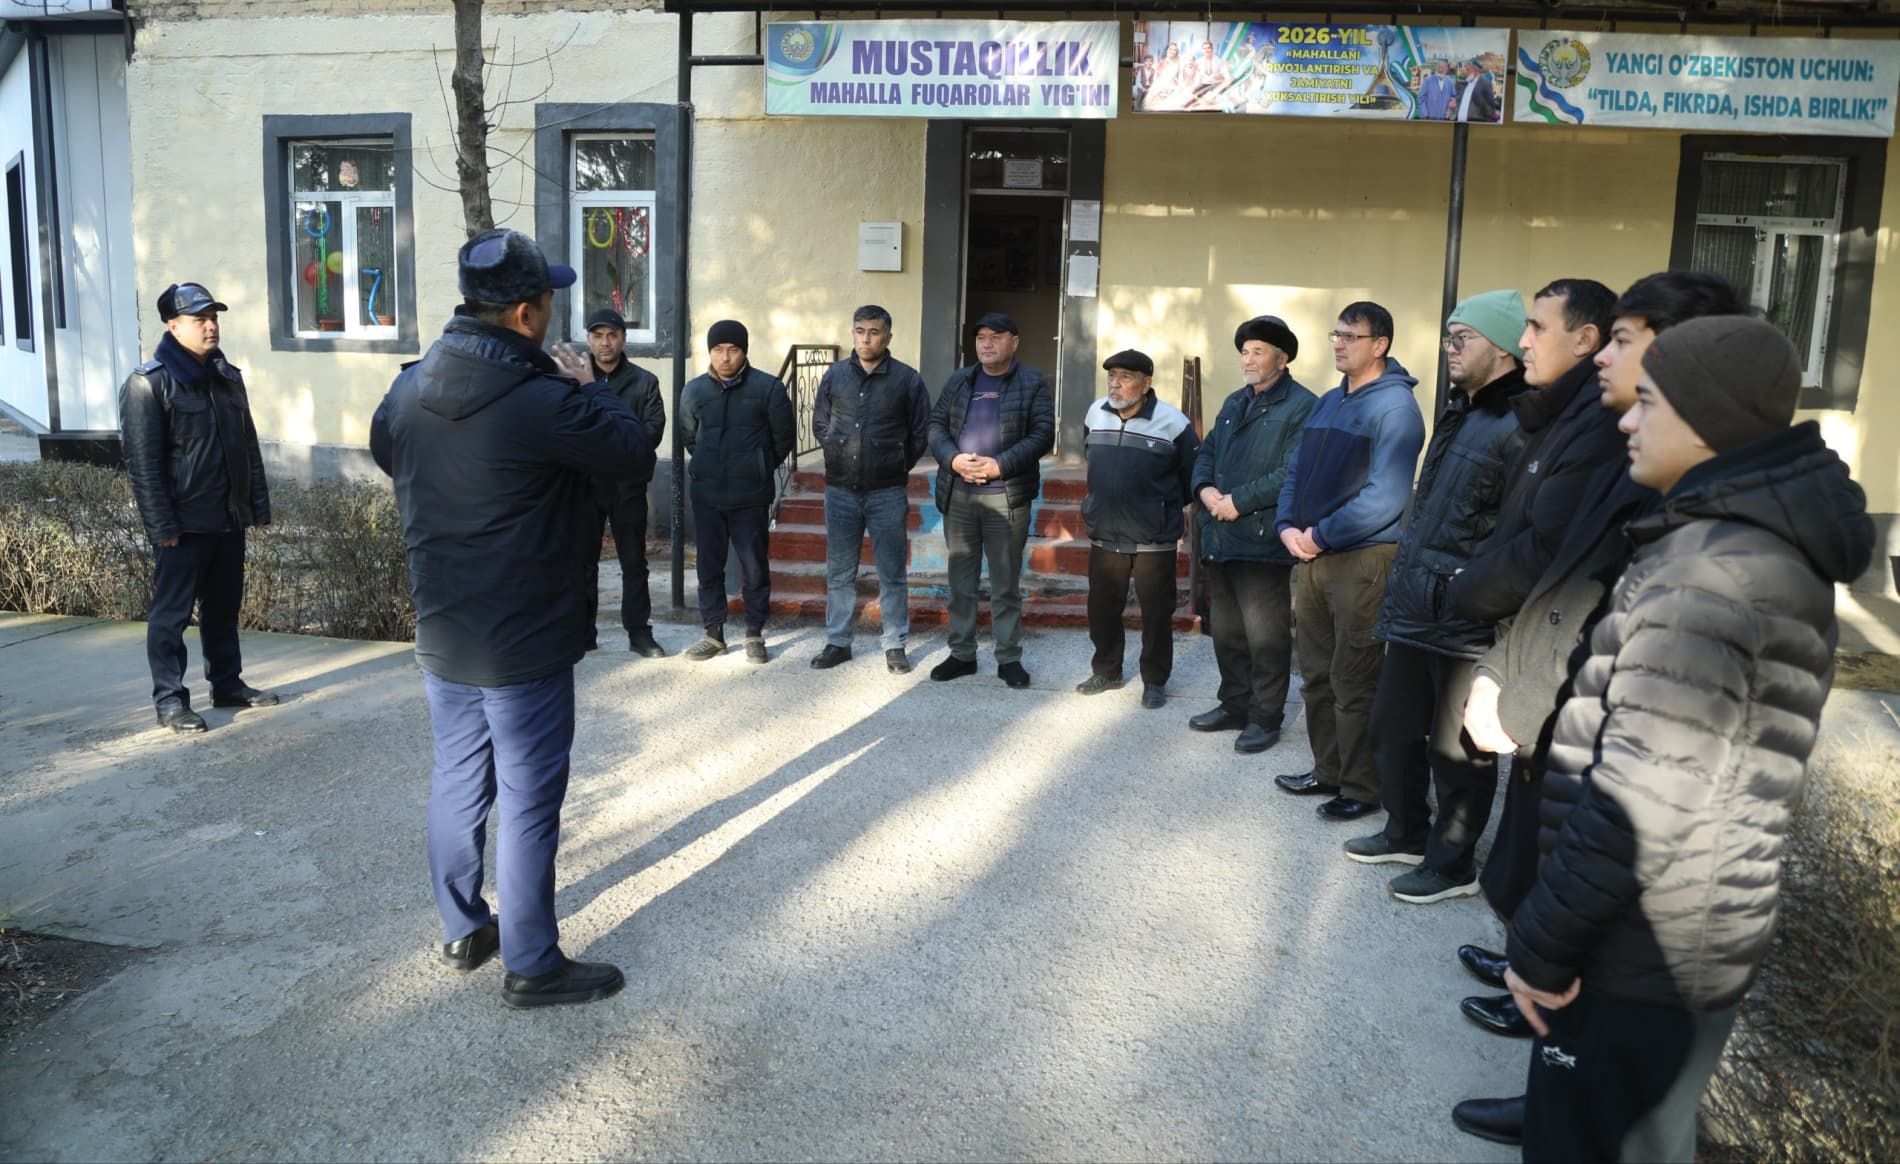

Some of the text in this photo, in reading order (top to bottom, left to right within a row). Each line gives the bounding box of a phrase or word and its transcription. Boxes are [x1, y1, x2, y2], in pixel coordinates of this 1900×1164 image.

[1277, 26, 1373, 45] 2026-YIL
[852, 40, 1093, 80] MUSTAQILLIK
[1265, 63, 1379, 75] RIVOJLANTIRISH VA
[1606, 52, 1663, 75] YANGI
[1800, 58, 1874, 81] UCHUN:
[1290, 77, 1352, 89] JAMIYATNI
[810, 82, 1110, 108] MAHALLA FUQAROLAR YIG'INI
[1264, 91, 1345, 103] YUKSALTIRISH
[1663, 91, 1738, 119] FIKRDA,
[1744, 94, 1802, 118] ISHDA
